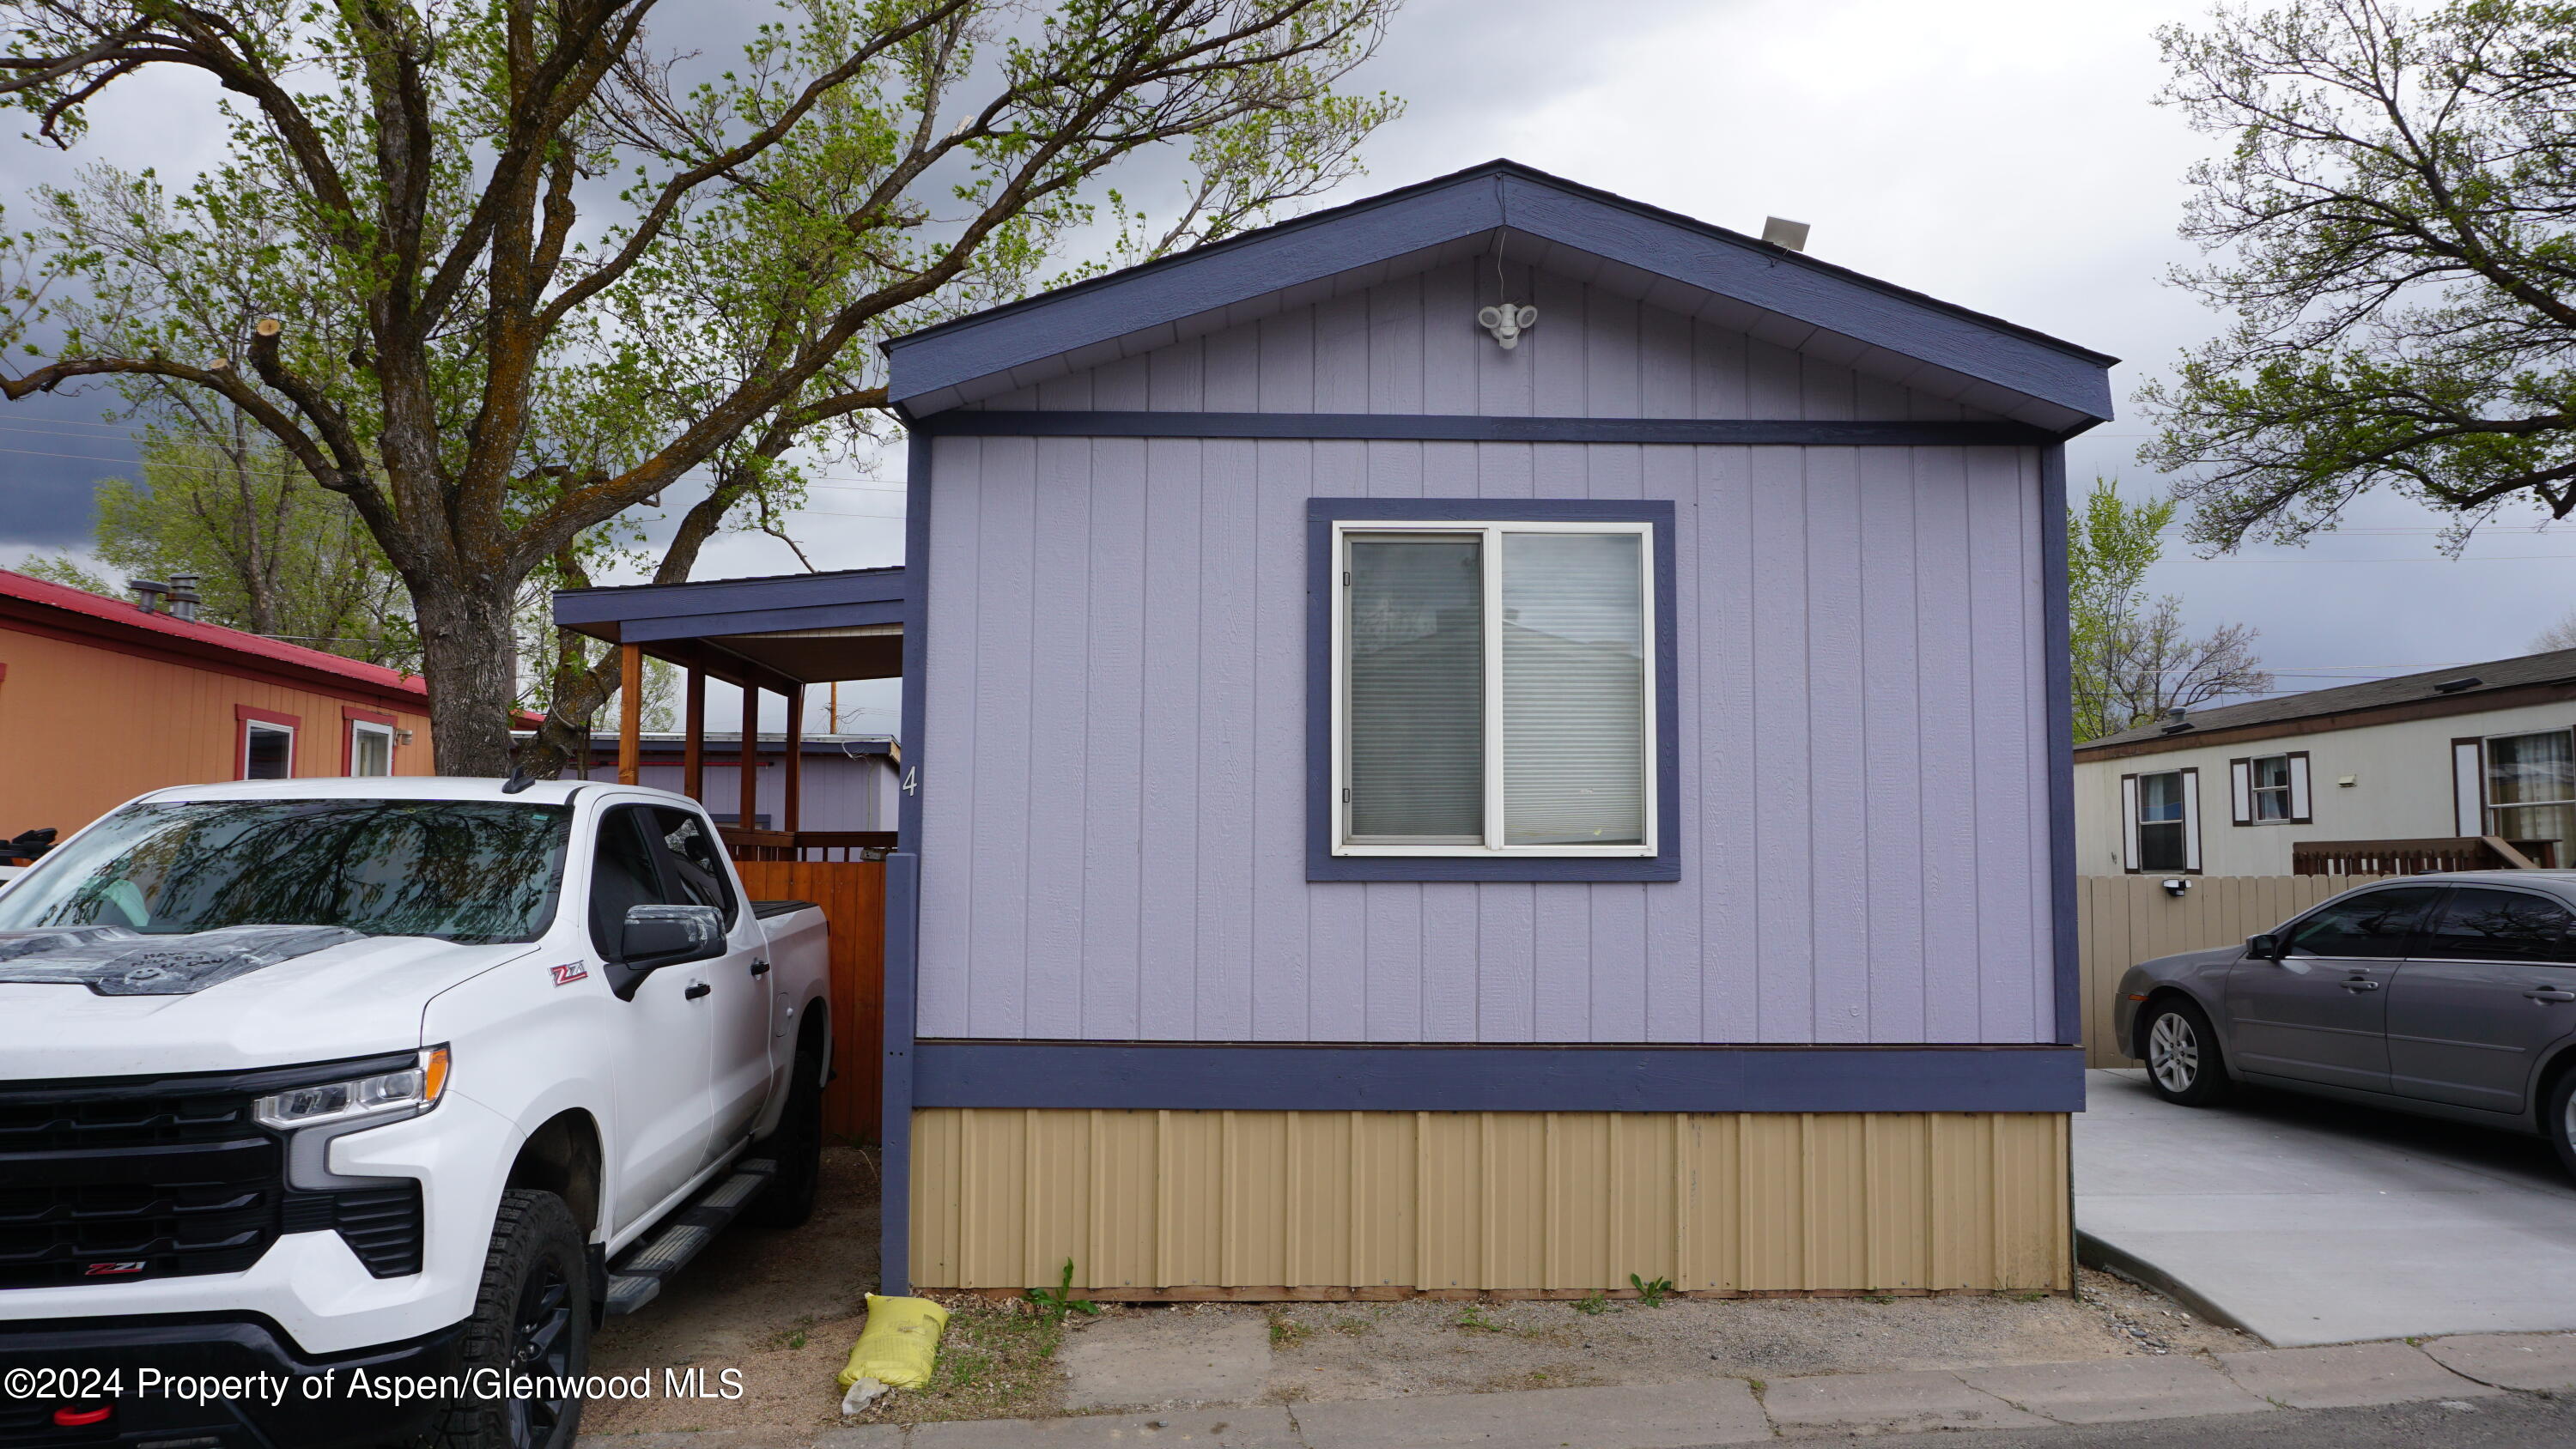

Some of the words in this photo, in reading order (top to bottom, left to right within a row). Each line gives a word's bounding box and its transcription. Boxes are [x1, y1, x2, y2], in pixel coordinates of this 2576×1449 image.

[902, 765, 917, 797] 4
[547, 960, 588, 988] Z71
[85, 1261, 146, 1276] Z71
